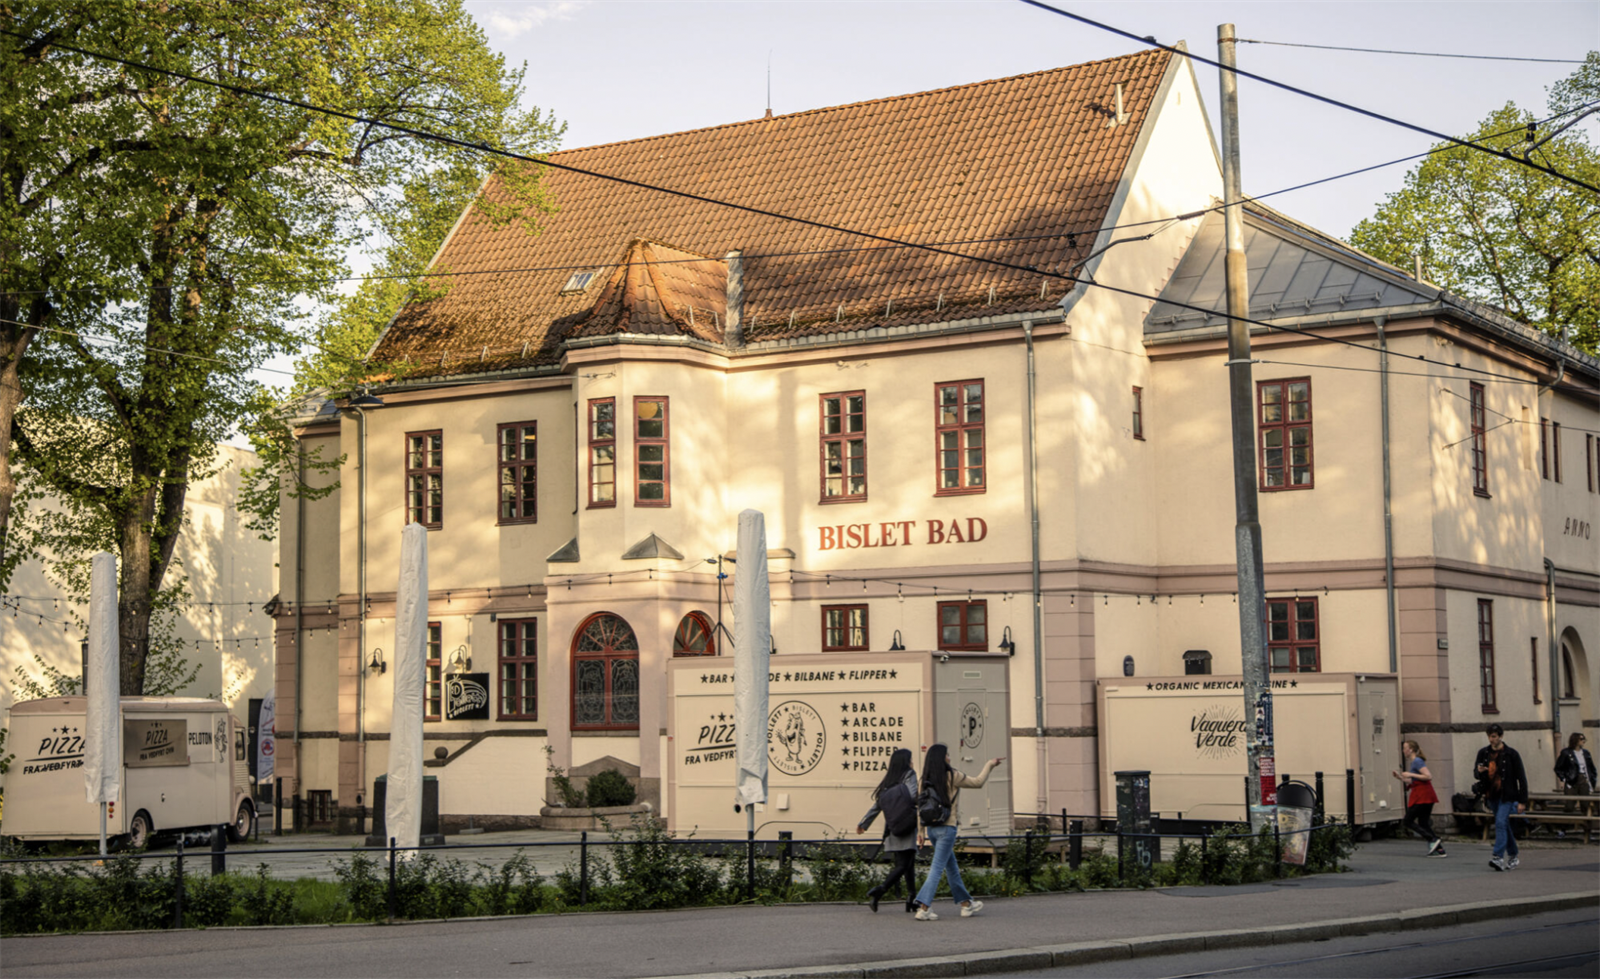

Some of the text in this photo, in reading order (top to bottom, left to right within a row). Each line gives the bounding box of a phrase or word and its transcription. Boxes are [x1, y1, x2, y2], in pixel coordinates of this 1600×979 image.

[818, 517, 988, 551] BISLET BAD
[1563, 516, 1591, 540] ANNO
[709, 674, 728, 683] BAR
[794, 671, 835, 682] BILBANE
[849, 670, 888, 680] FLIPPER
[1155, 681, 1200, 691] ORGANIC
[792, 705, 816, 720] BISLETT
[852, 702, 876, 712] BAR
[853, 717, 904, 727] ARCADE
[969, 716, 977, 737] P
[145, 729, 168, 745] PIZZA
[188, 732, 212, 745] PELOTON
[698, 724, 735, 744] PIZZ
[853, 731, 902, 742] BILBANE
[1196, 731, 1237, 749] Verde
[808, 732, 823, 767] POLLETT
[139, 752, 147, 761] FRA
[685, 750, 737, 765] FRA VEDFYR
[23, 765, 41, 775] FRA
[773, 756, 797, 771] BISLETT
[853, 761, 888, 771] PIZZA
